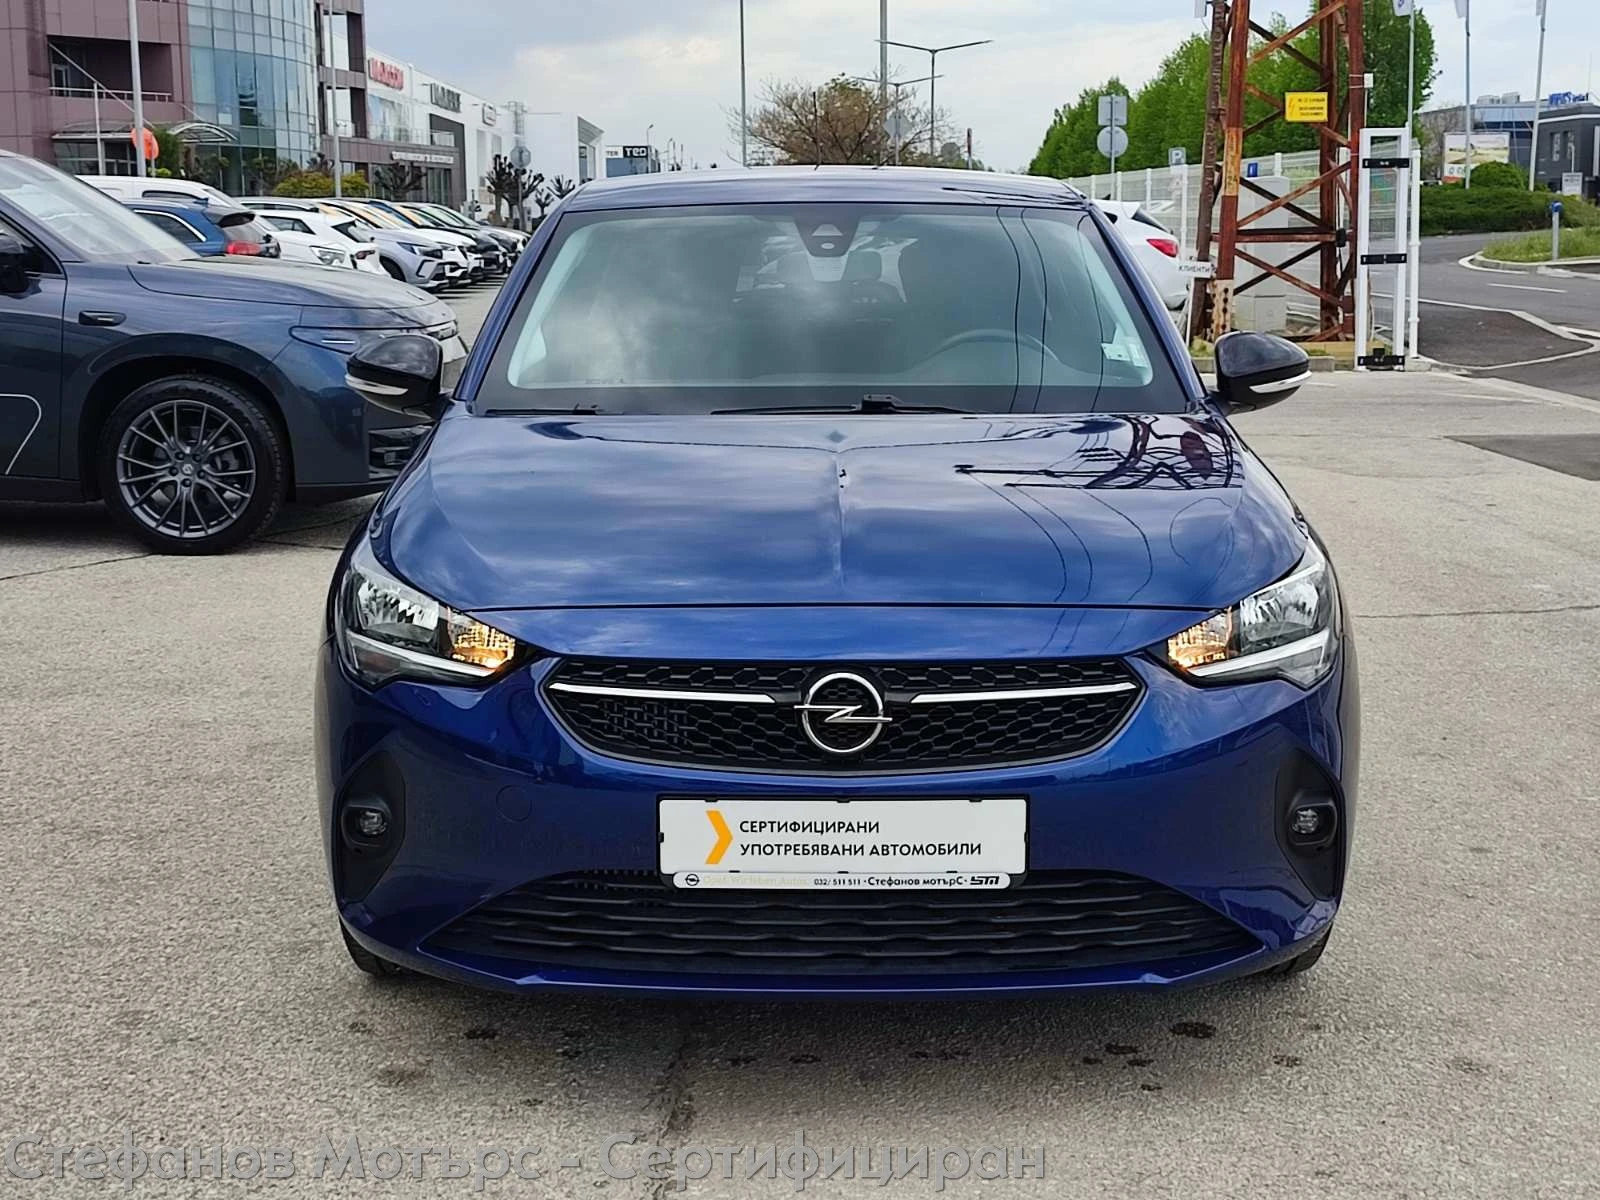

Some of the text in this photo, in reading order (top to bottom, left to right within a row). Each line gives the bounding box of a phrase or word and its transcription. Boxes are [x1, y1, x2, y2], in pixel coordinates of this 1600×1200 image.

[739, 820, 880, 835] СЕРТИФИЦИРАНИ
[740, 843, 982, 857] УПОТРЕБЯВАНИ АВТОМОБИЛИ
